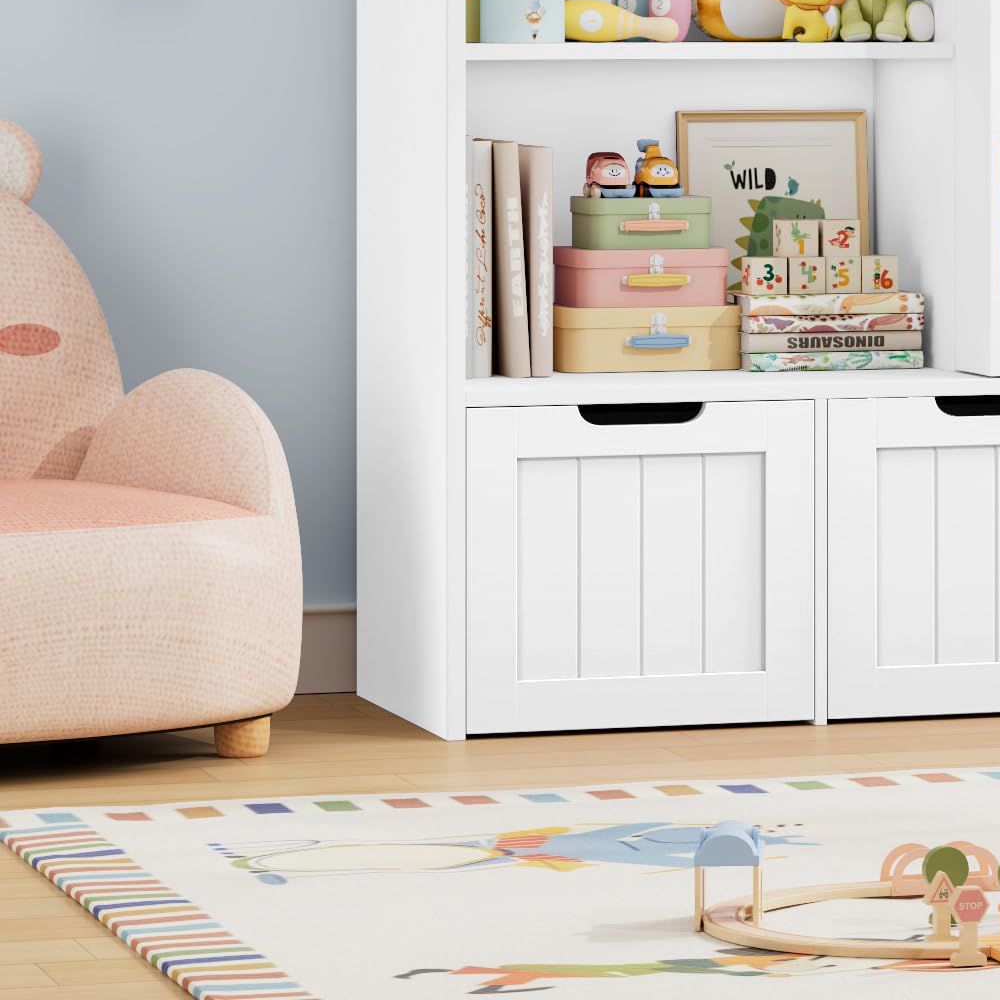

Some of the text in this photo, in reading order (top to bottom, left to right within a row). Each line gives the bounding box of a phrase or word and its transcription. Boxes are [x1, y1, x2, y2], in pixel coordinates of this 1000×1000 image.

[622, 0, 629, 10] 3
[655, 0, 664, 10] 2
[730, 167, 776, 190] WILD
[836, 229, 850, 249] 2
[506, 197, 524, 318] EARTH
[762, 263, 775, 282] 3
[801, 265, 814, 284] 4
[838, 268, 850, 287] 5
[880, 269, 894, 289] 6
[786, 335, 886, 350] DINOSAURS
[958, 902, 983, 911] STOP
